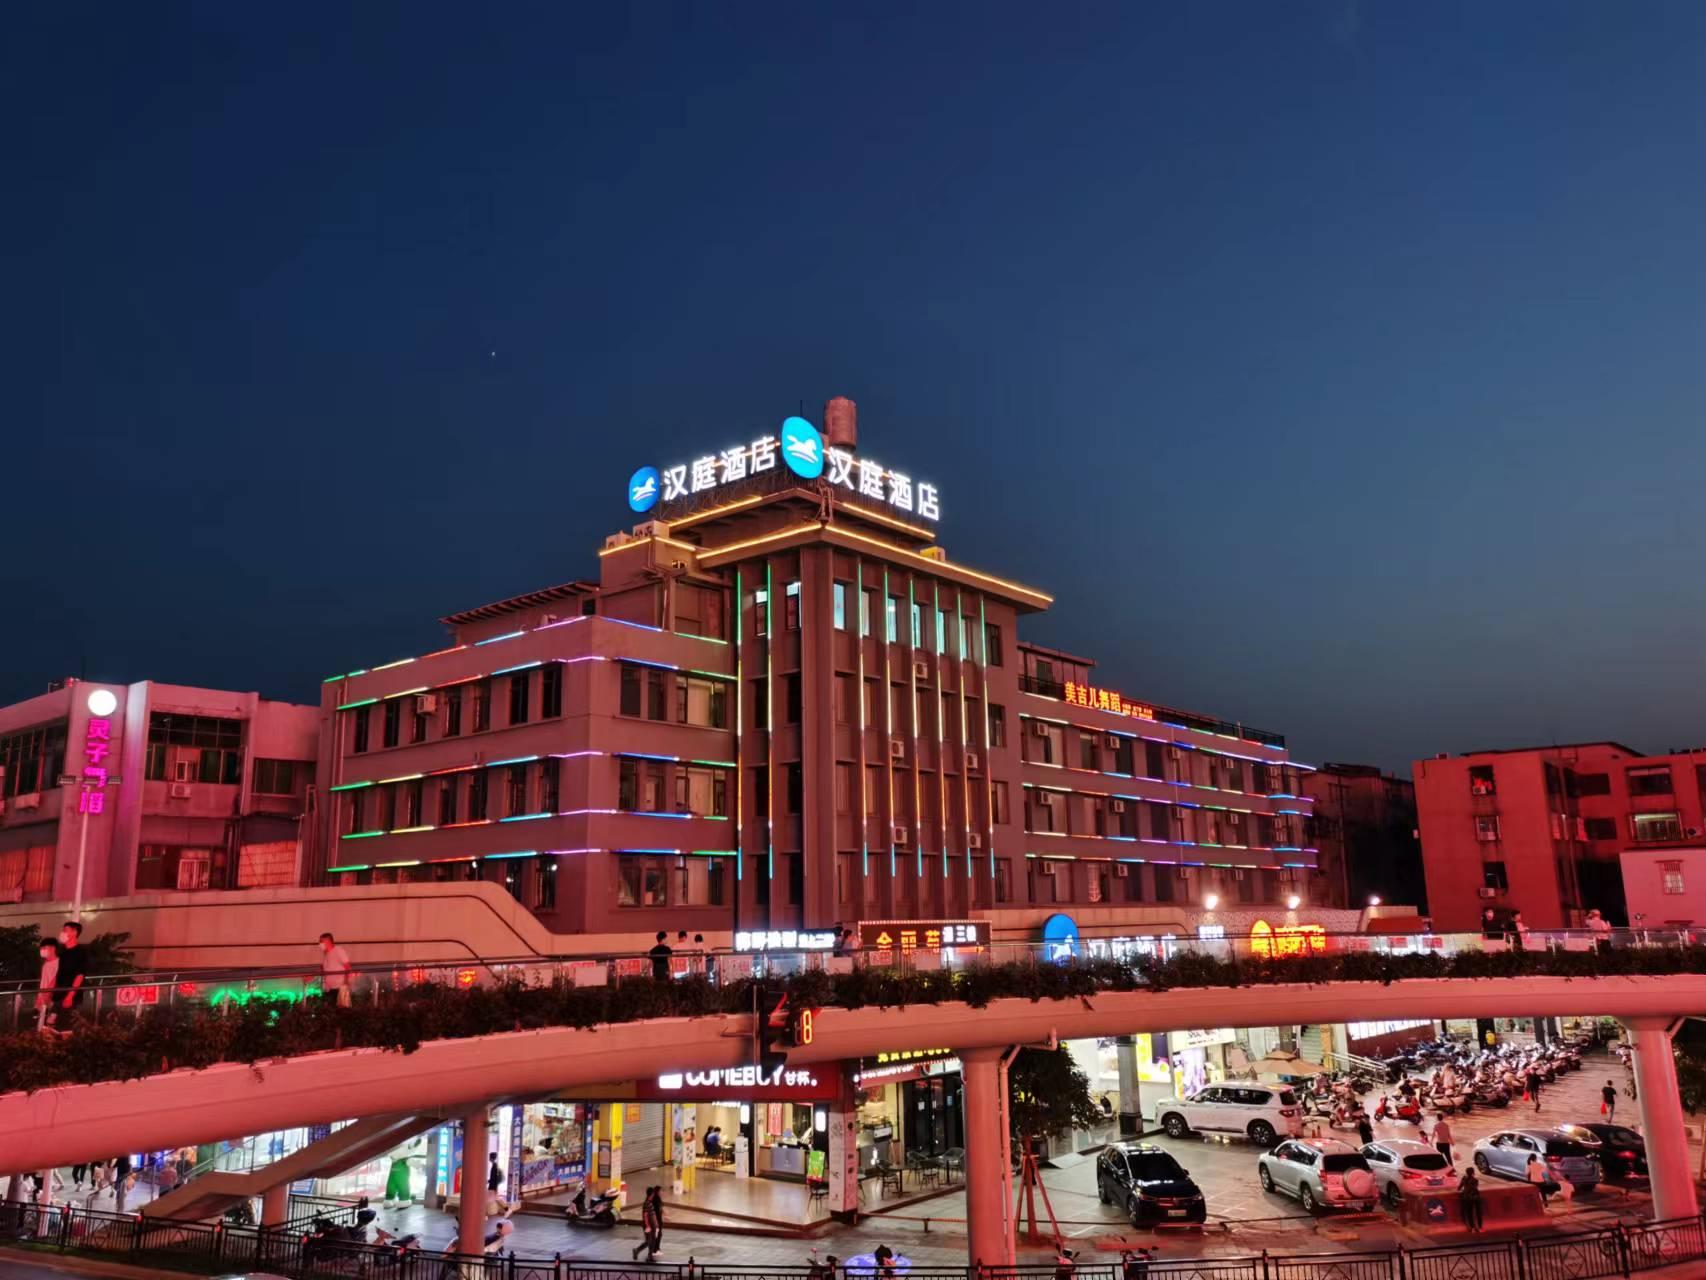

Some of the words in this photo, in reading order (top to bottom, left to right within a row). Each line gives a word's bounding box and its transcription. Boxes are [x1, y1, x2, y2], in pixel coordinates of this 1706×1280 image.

[663, 436, 775, 501] 汉庭酒店
[828, 446, 940, 520] 汉庭酒店
